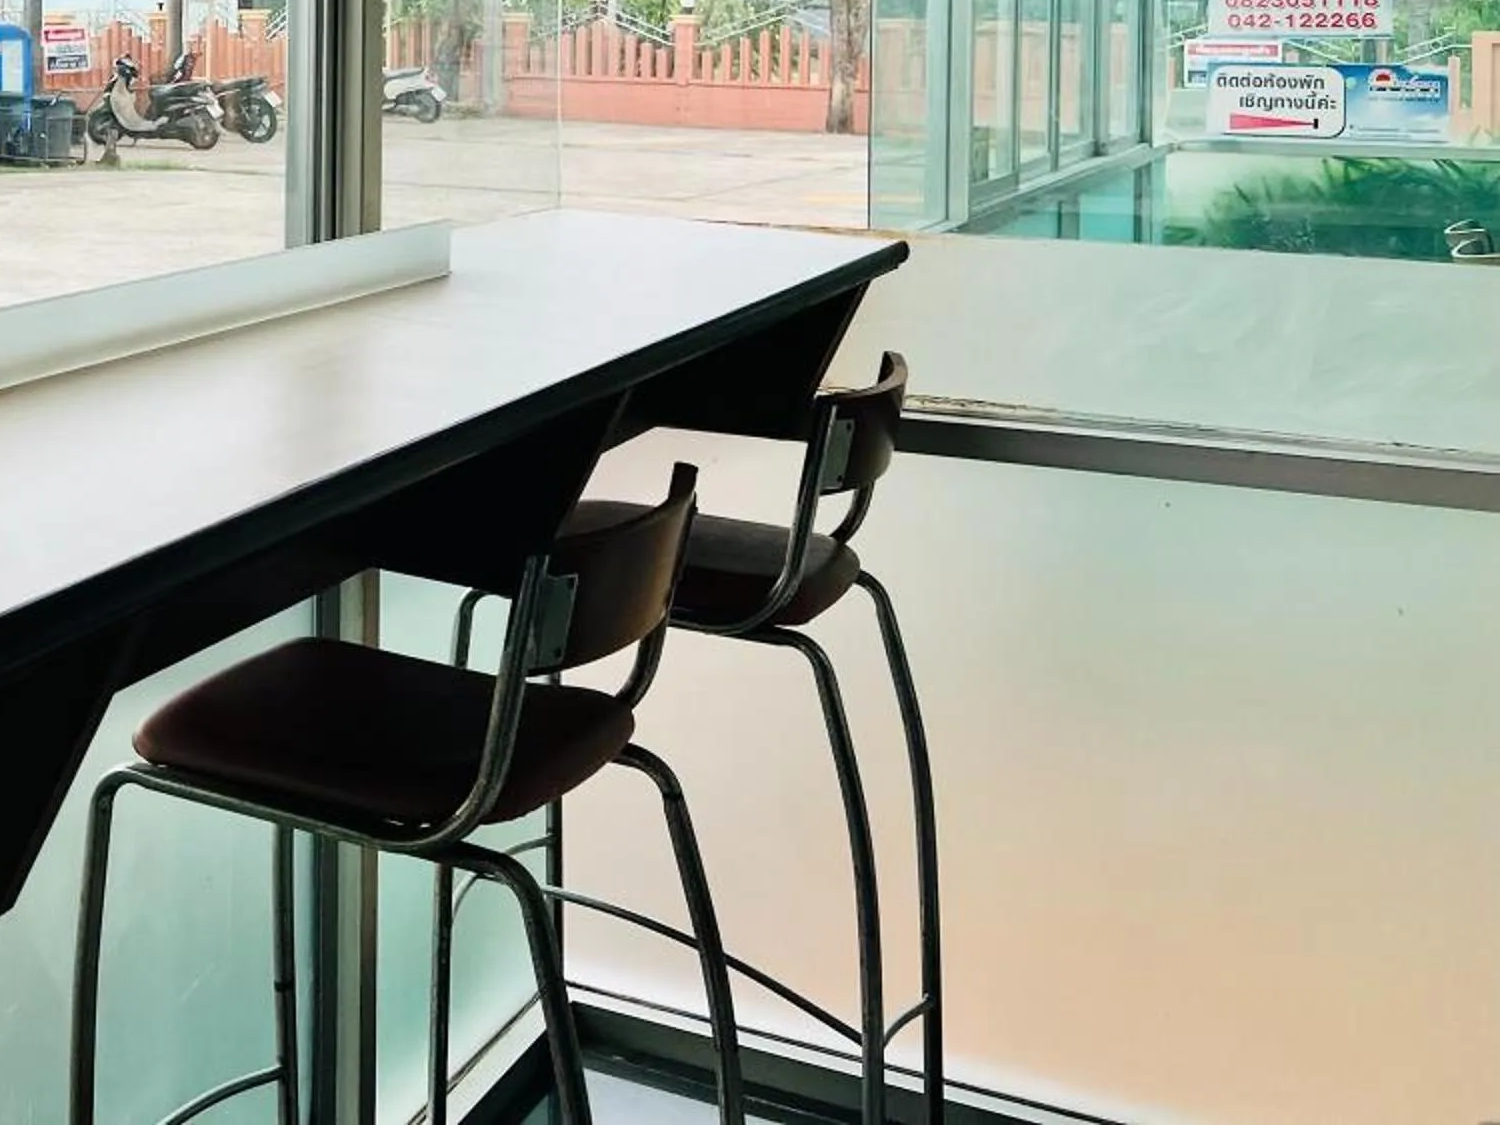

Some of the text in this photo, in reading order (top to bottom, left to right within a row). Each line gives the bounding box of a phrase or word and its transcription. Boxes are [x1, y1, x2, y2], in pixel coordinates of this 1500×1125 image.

[1227, 13, 1376, 28] 042-122266
[1217, 72, 1325, 90] ติดต่อห้องพัก
[1239, 91, 1338, 112] เชิญทางนี้ค่ะ
